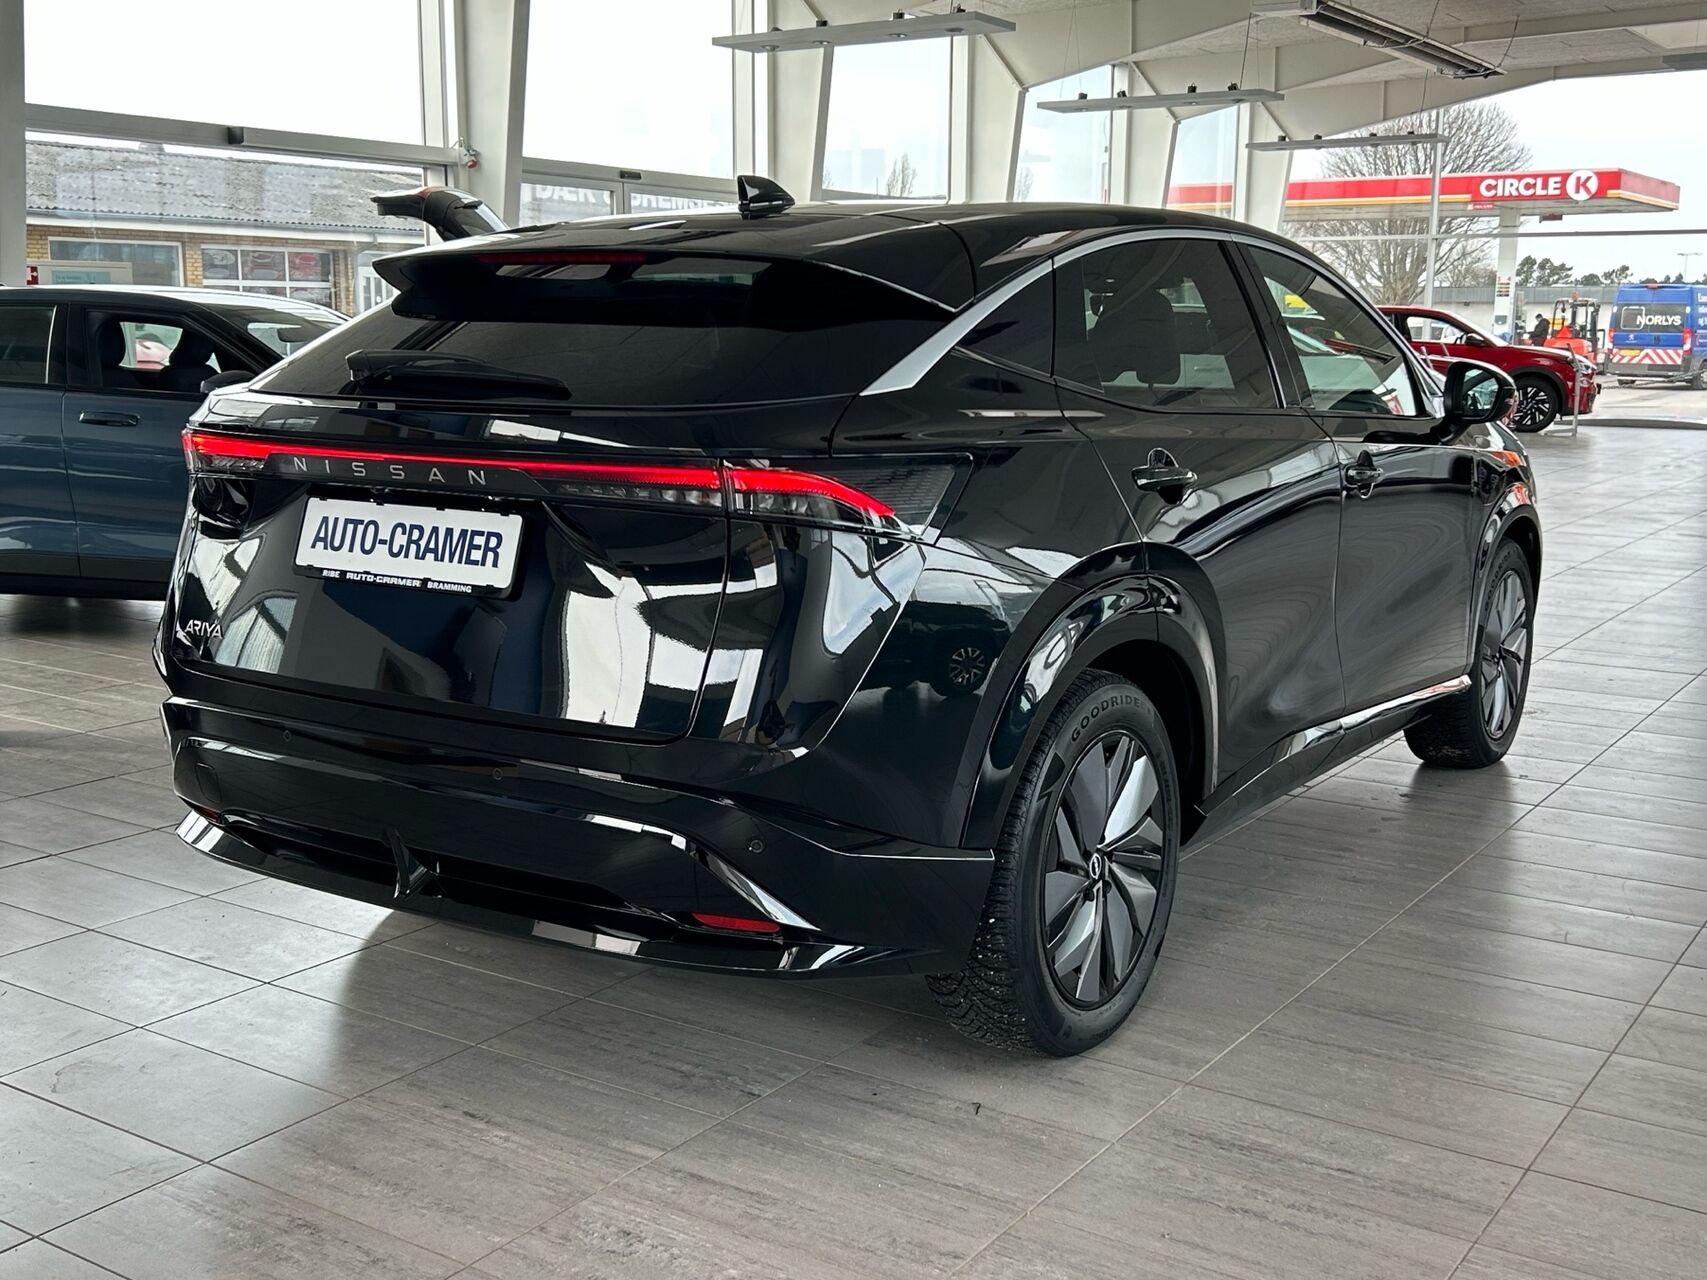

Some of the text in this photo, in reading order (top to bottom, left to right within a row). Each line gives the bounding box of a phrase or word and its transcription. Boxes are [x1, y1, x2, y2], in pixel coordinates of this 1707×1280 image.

[1480, 175, 1594, 198] CIRCLE K
[1636, 315, 1682, 326] NORLYS
[293, 456, 487, 486] NISSAN
[310, 515, 504, 569] AUTO-CRAMER
[322, 569, 473, 594] RIBE AUTO-CRAMER BRAMMING
[184, 619, 224, 640] ARIYA
[1071, 695, 1141, 742] GOODRIDE
